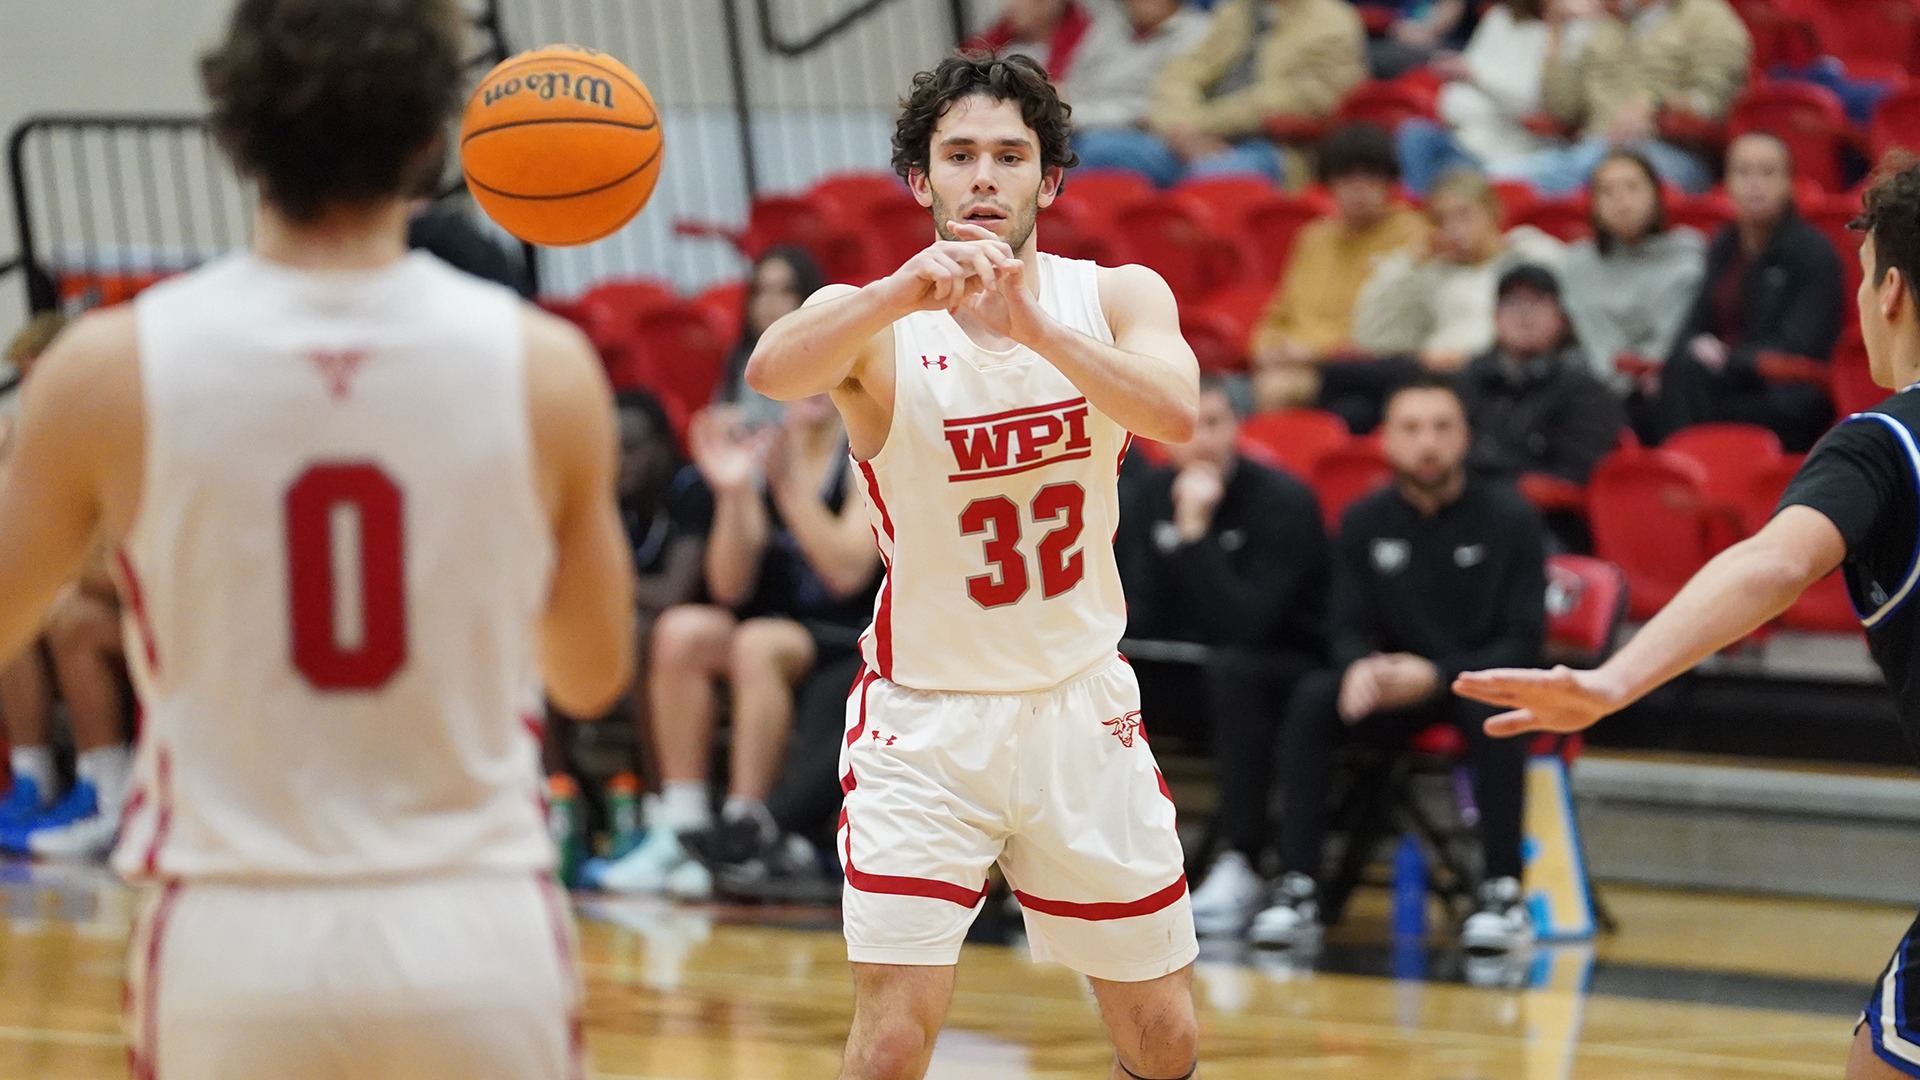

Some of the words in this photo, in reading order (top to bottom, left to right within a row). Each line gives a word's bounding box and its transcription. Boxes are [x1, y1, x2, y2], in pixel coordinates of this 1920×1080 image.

[484, 72, 614, 108] Wilson
[944, 406, 1092, 471] WPI
[284, 461, 406, 692] 0
[958, 480, 1086, 610] 32
